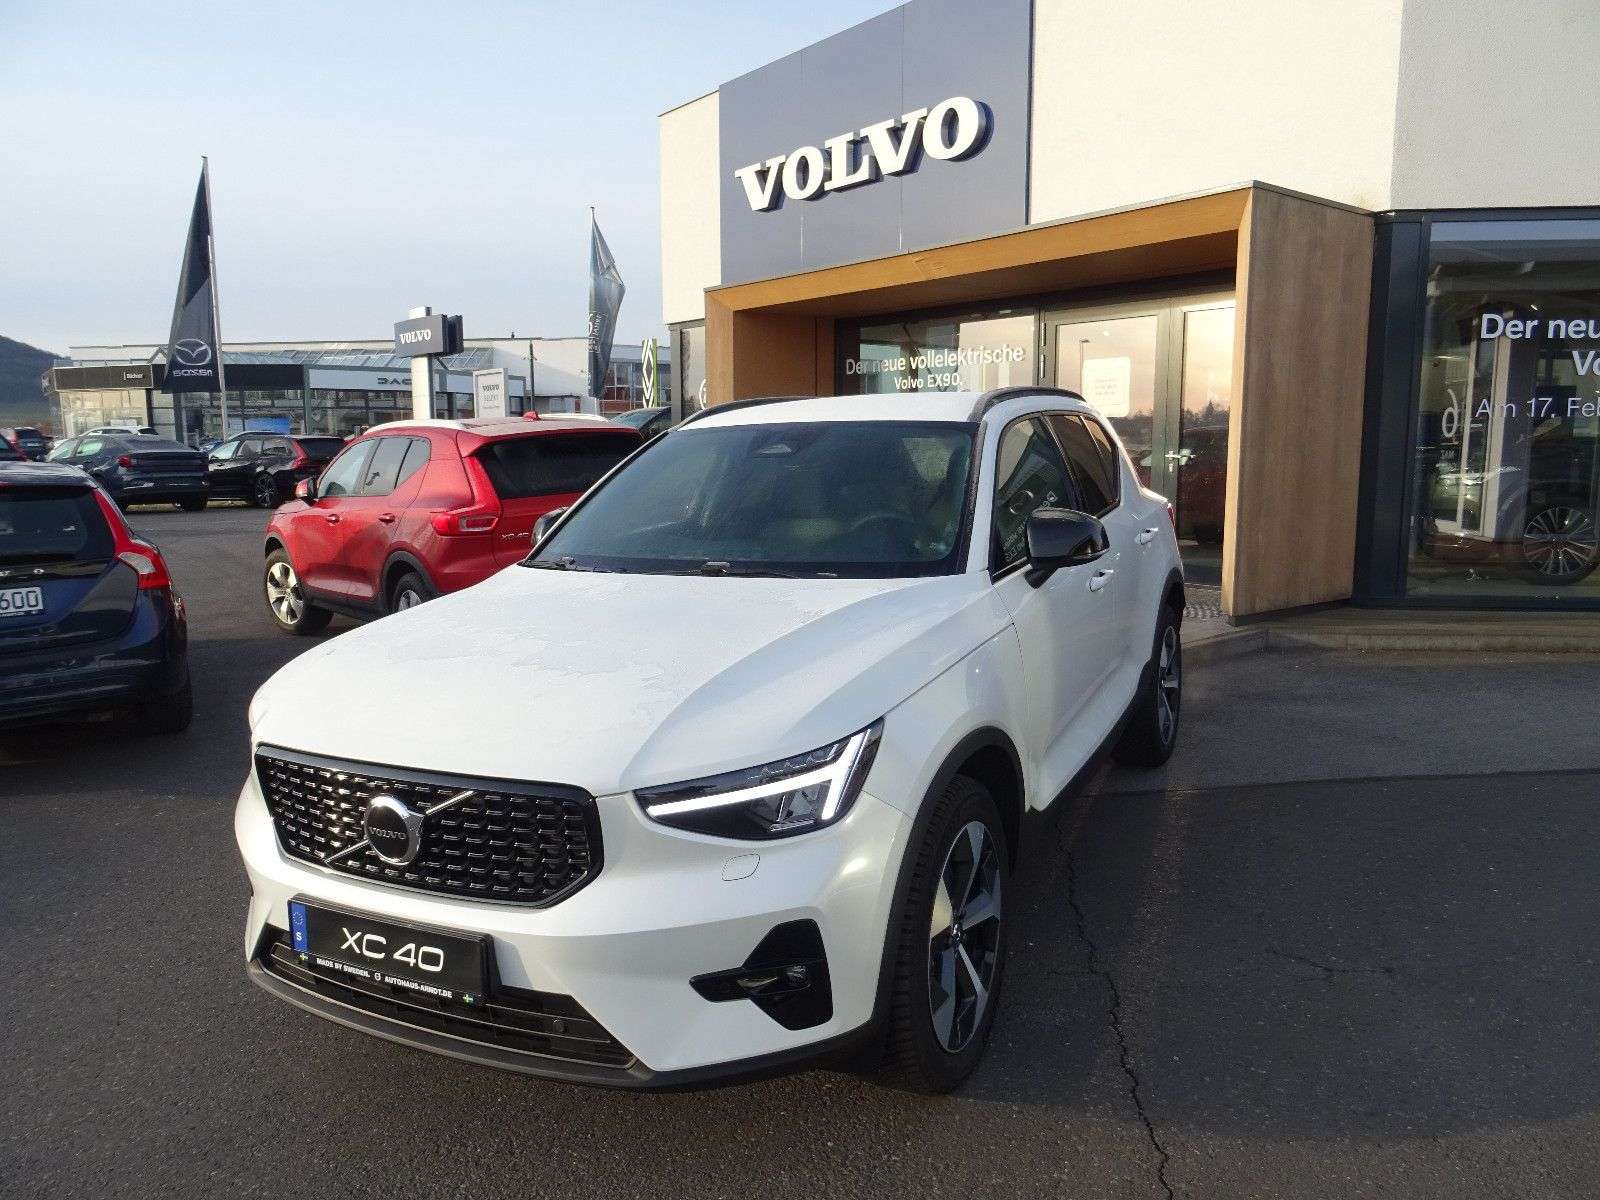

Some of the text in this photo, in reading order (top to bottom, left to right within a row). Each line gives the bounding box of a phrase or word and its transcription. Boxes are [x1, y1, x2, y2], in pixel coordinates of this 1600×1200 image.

[735, 96, 992, 212] VOLVO
[1480, 313, 1538, 340] Der
[400, 329, 432, 345] VOLVO
[845, 344, 1025, 375] Der neue vollelektrische
[377, 377, 412, 385] DAC
[894, 375, 924, 390] Volvo
[1474, 397, 1600, 419] Am 17. Fe
[368, 826, 407, 840] VOLVO
[295, 931, 302, 941] S
[316, 958, 334, 968] MADE
